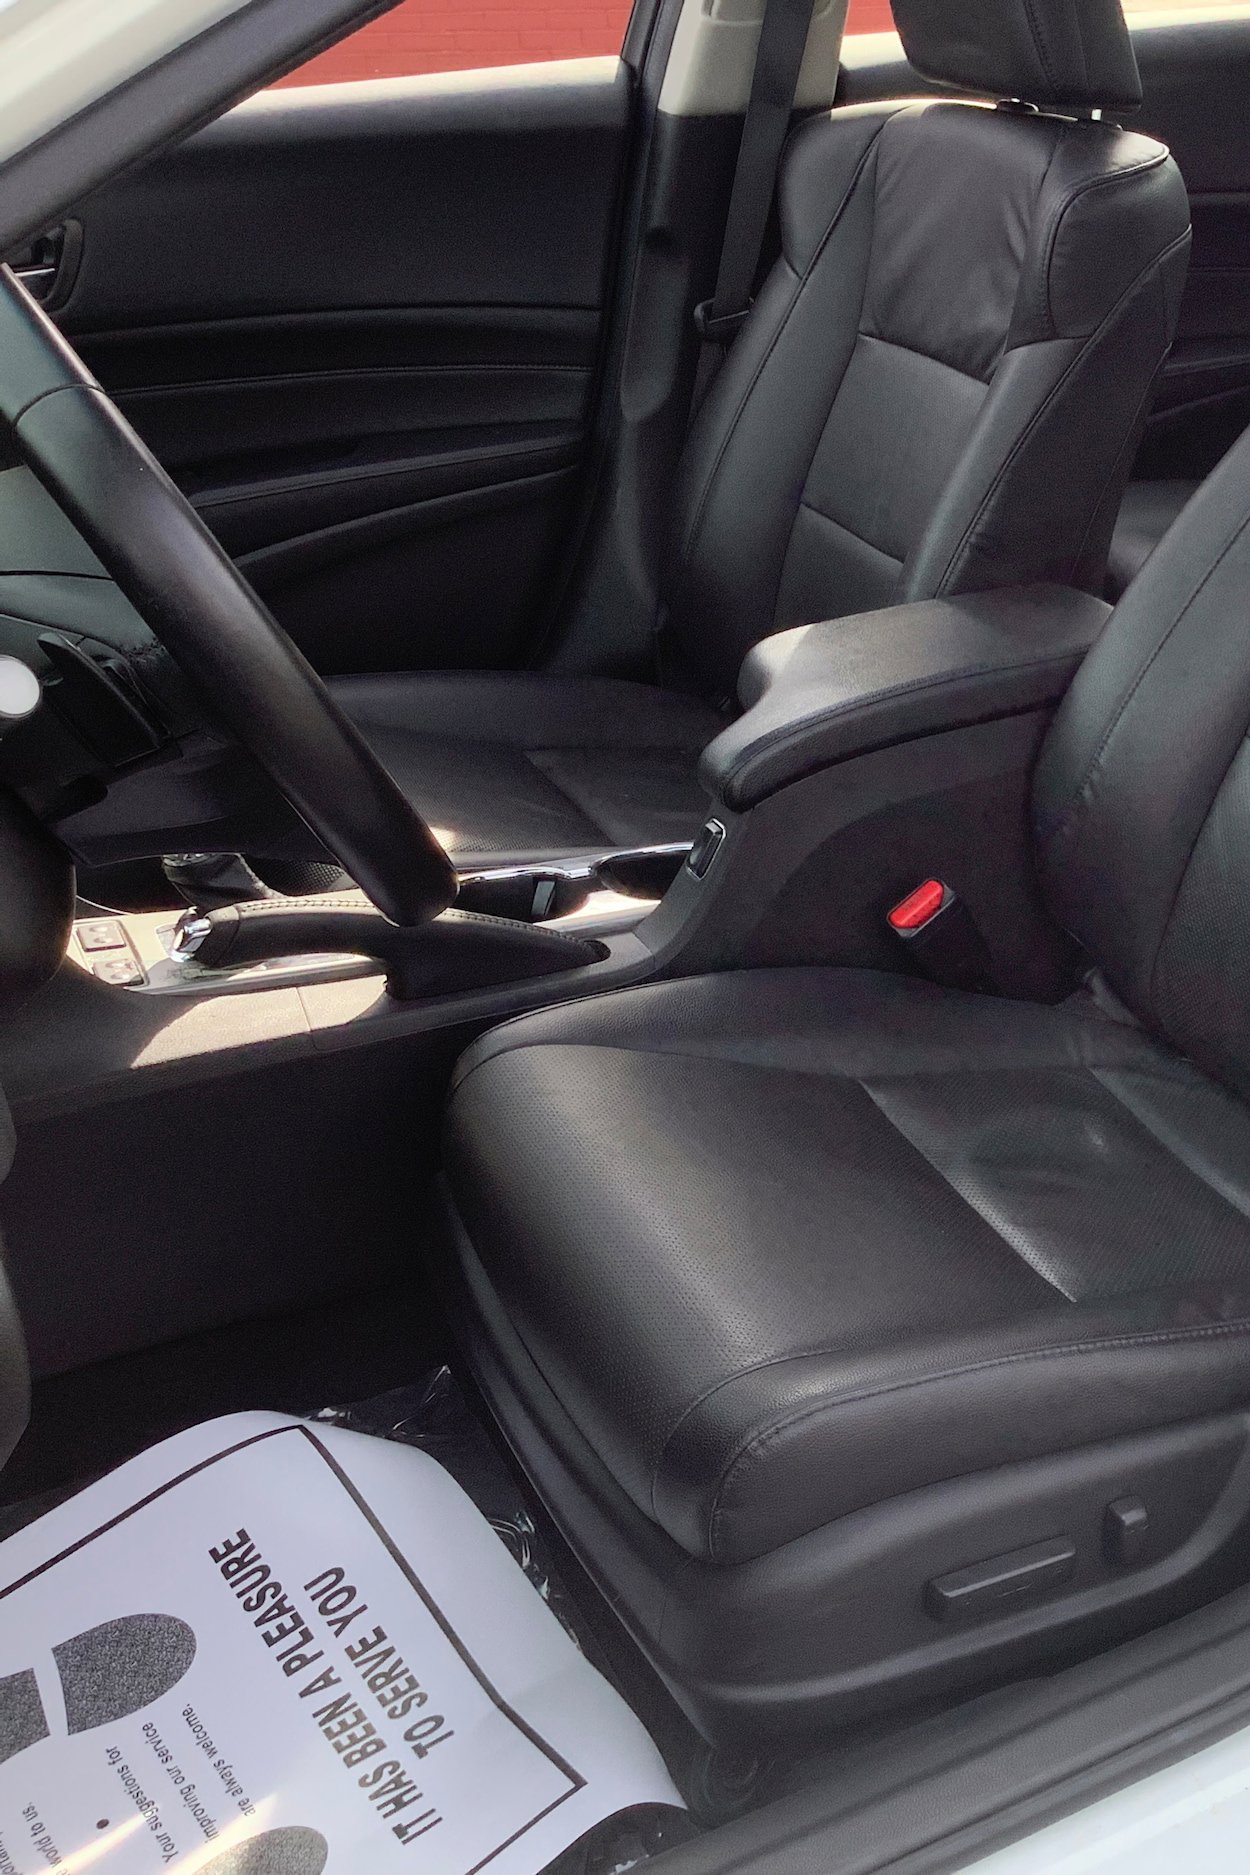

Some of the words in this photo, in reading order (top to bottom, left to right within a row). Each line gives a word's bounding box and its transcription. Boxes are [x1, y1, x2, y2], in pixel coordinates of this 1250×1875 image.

[209, 1528, 324, 1677] PLEASURE
[304, 1567, 368, 1638] YOU
[299, 1666, 341, 1698] A
[345, 1626, 428, 1719] SERVE
[142, 1722, 172, 1764] service
[182, 1703, 219, 1759] welcome.
[312, 1693, 386, 1768] BEEN
[404, 1715, 454, 1759] TO
[105, 1746, 123, 1766] for
[166, 1765, 185, 1785] our
[117, 1764, 162, 1831] suggestions
[214, 1759, 243, 1797] always
[359, 1761, 423, 1819] HAS
[180, 1784, 219, 1843] improving
[238, 1797, 255, 1816] are
[392, 1809, 443, 1845] IT
[31, 1822, 46, 1837] to
[156, 1832, 178, 1863] Your
[33, 1835, 62, 1868] world
